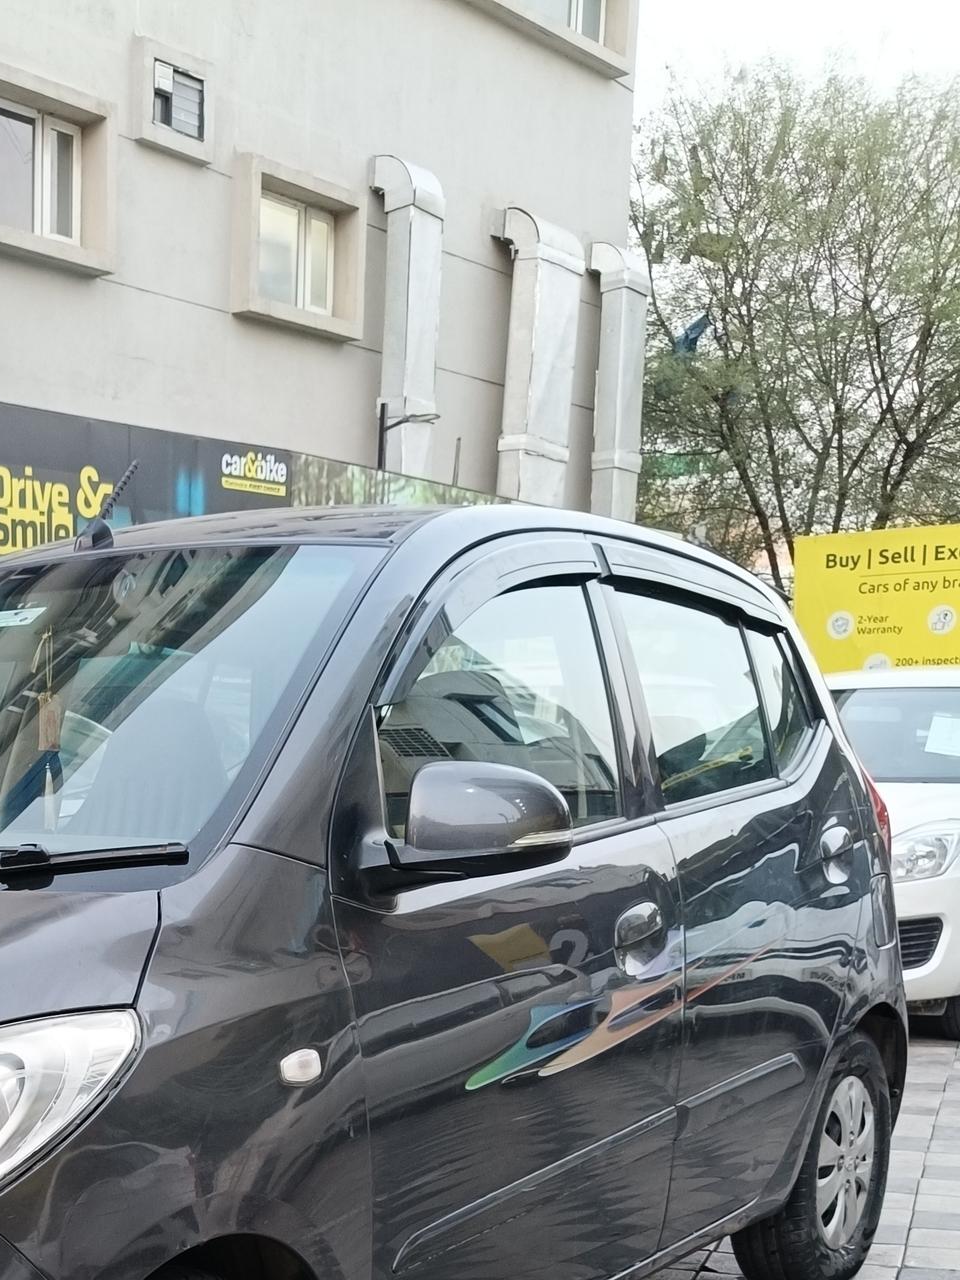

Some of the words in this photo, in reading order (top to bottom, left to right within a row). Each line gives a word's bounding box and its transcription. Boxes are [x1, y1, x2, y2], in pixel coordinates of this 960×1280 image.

[221, 451, 287, 483] car&bike
[76, 465, 114, 519] &
[825, 553, 861, 571] Buy
[878, 546, 916, 565] Sell
[934, 545, 960, 561] Ex
[858, 582, 889, 595] Cars
[893, 578, 910, 593] of
[912, 580, 938, 593] any
[942, 575, 960, 590] br
[857, 614, 889, 624] 2-Year
[856, 625, 903, 635] Warranty
[895, 657, 920, 667] 200+
